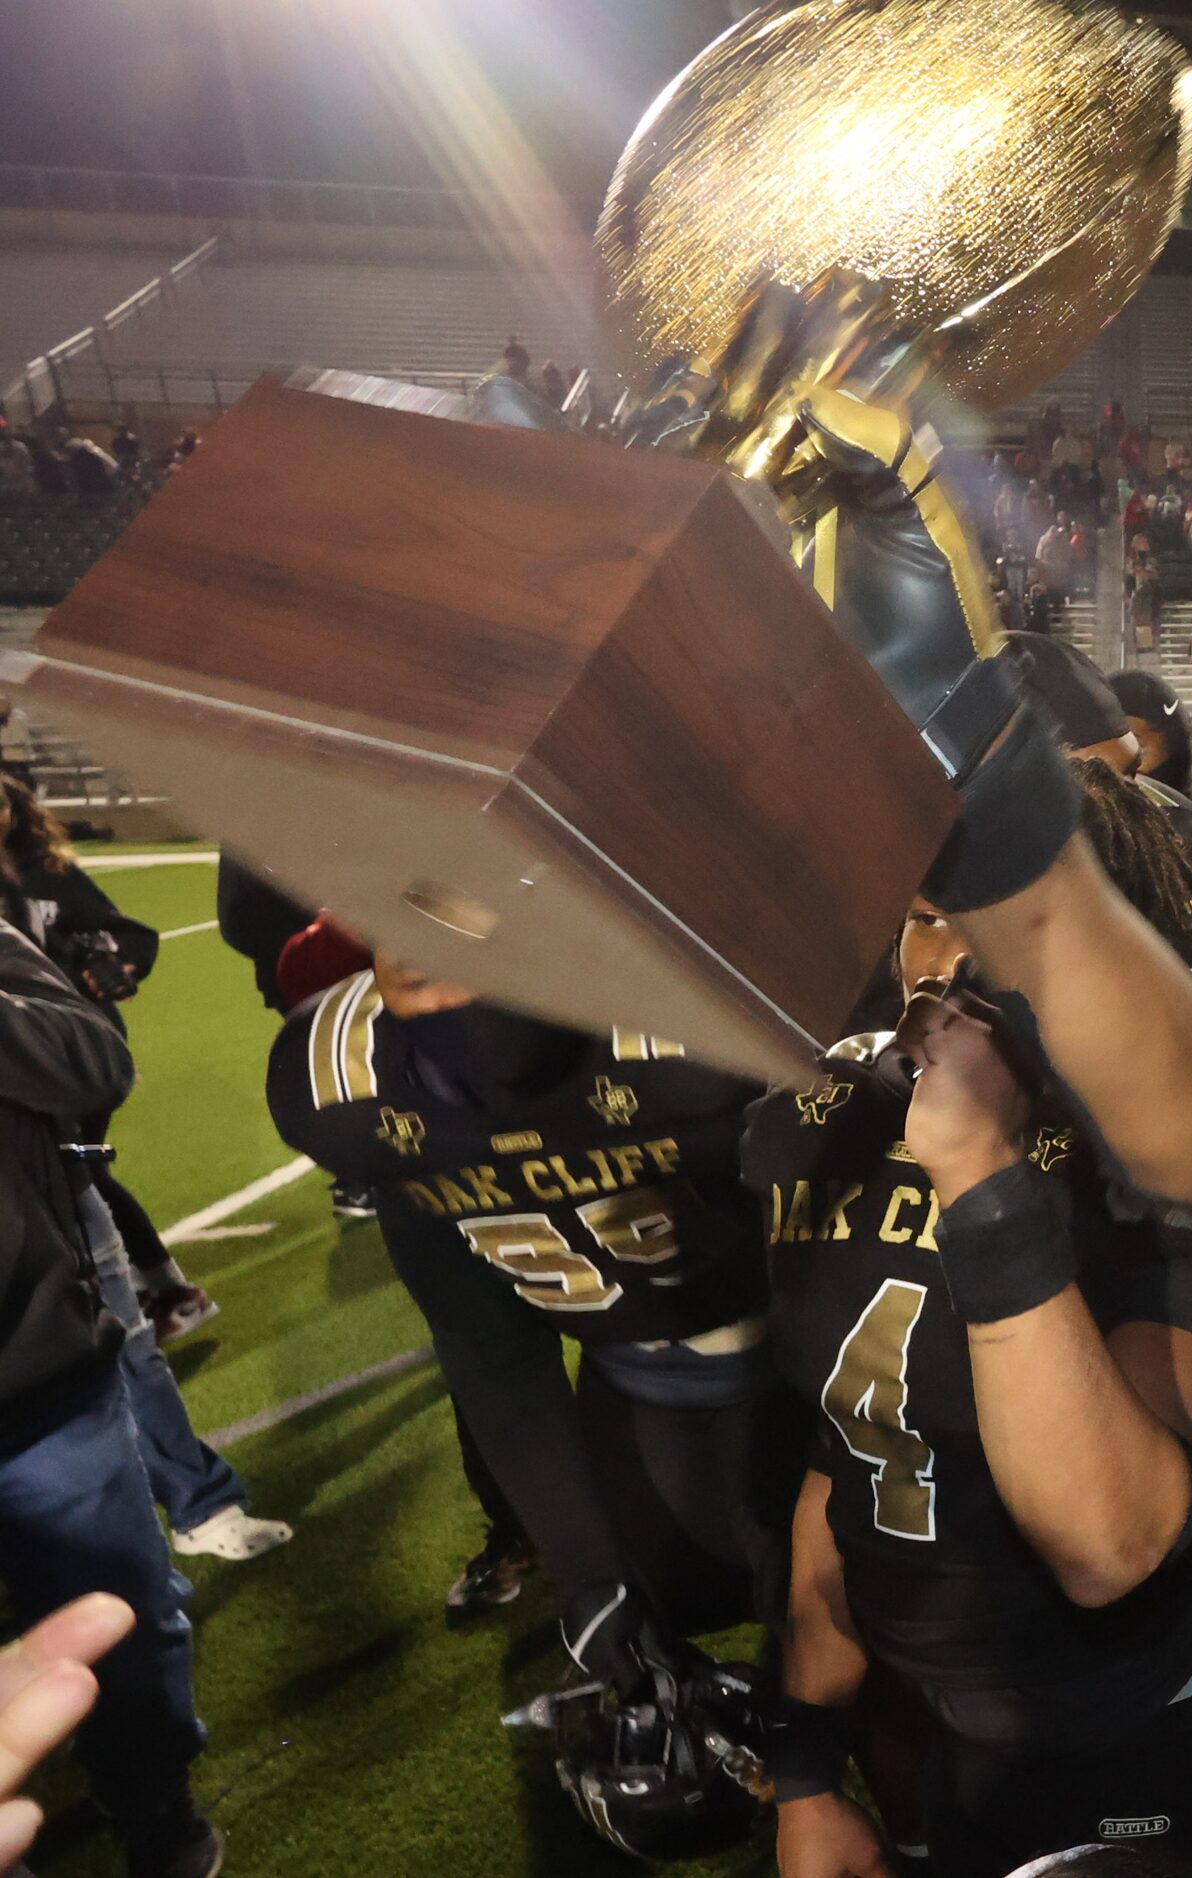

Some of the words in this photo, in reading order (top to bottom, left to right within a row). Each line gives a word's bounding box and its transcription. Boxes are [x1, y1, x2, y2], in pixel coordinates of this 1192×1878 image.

[521, 1136, 681, 1202] CLIFF
[820, 1277, 937, 1542] 4
[1102, 1819, 1165, 1836] BATTLE
